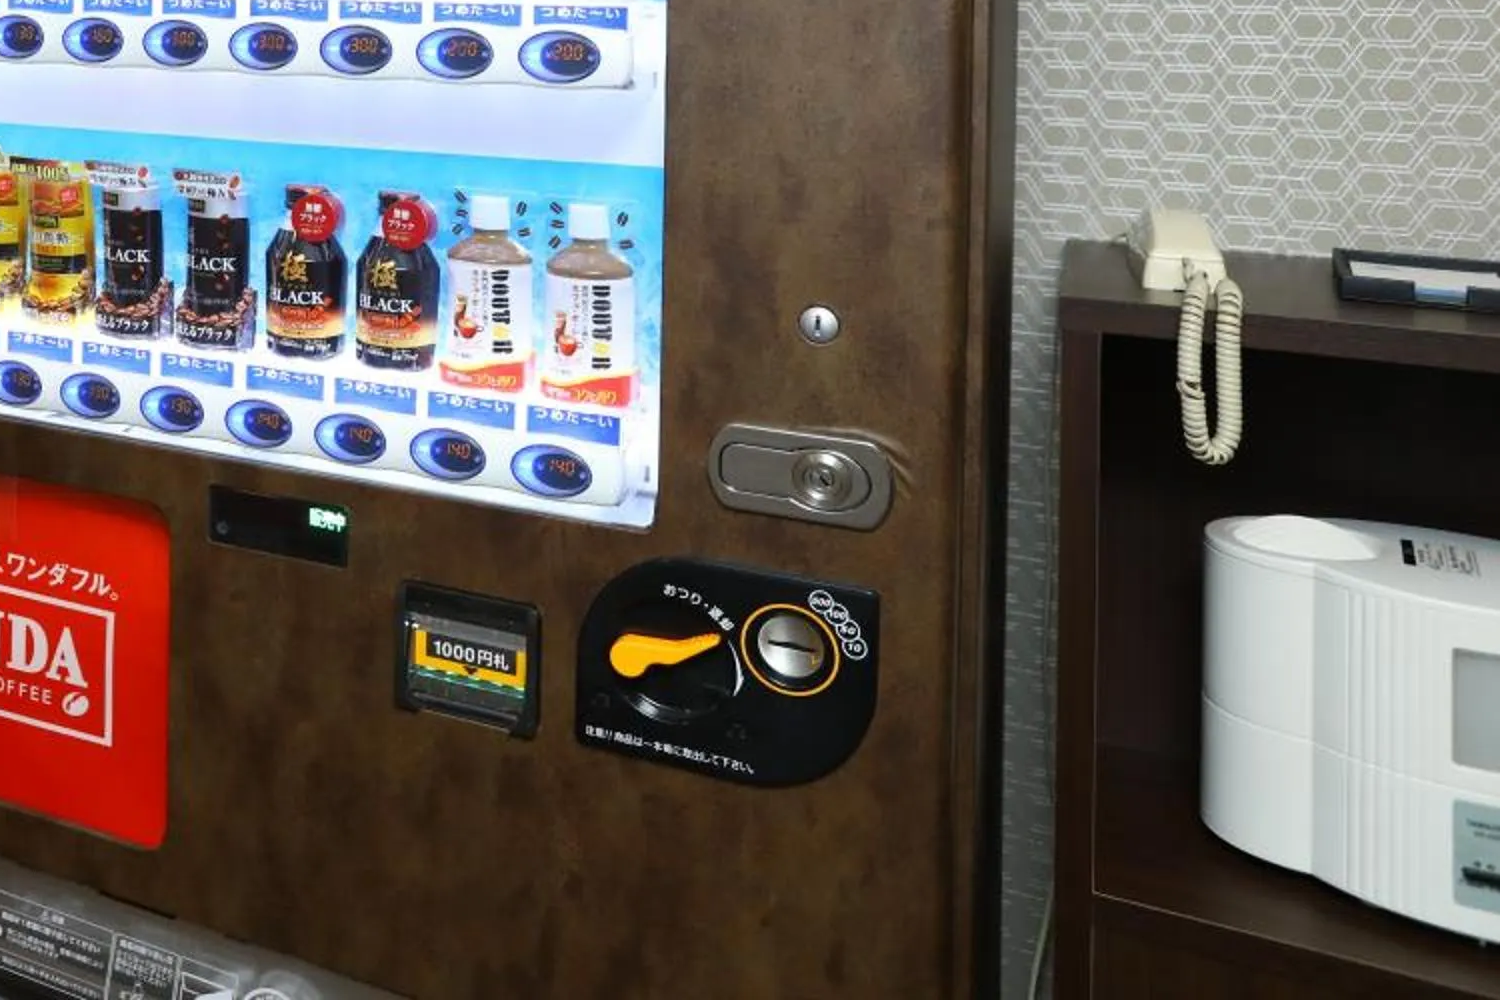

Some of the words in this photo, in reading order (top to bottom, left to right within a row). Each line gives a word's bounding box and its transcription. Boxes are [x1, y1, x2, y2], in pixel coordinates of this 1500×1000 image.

[359, 293, 414, 313] BLACK
[433, 639, 509, 672] 1000円札
[848, 642, 862, 653] 10
